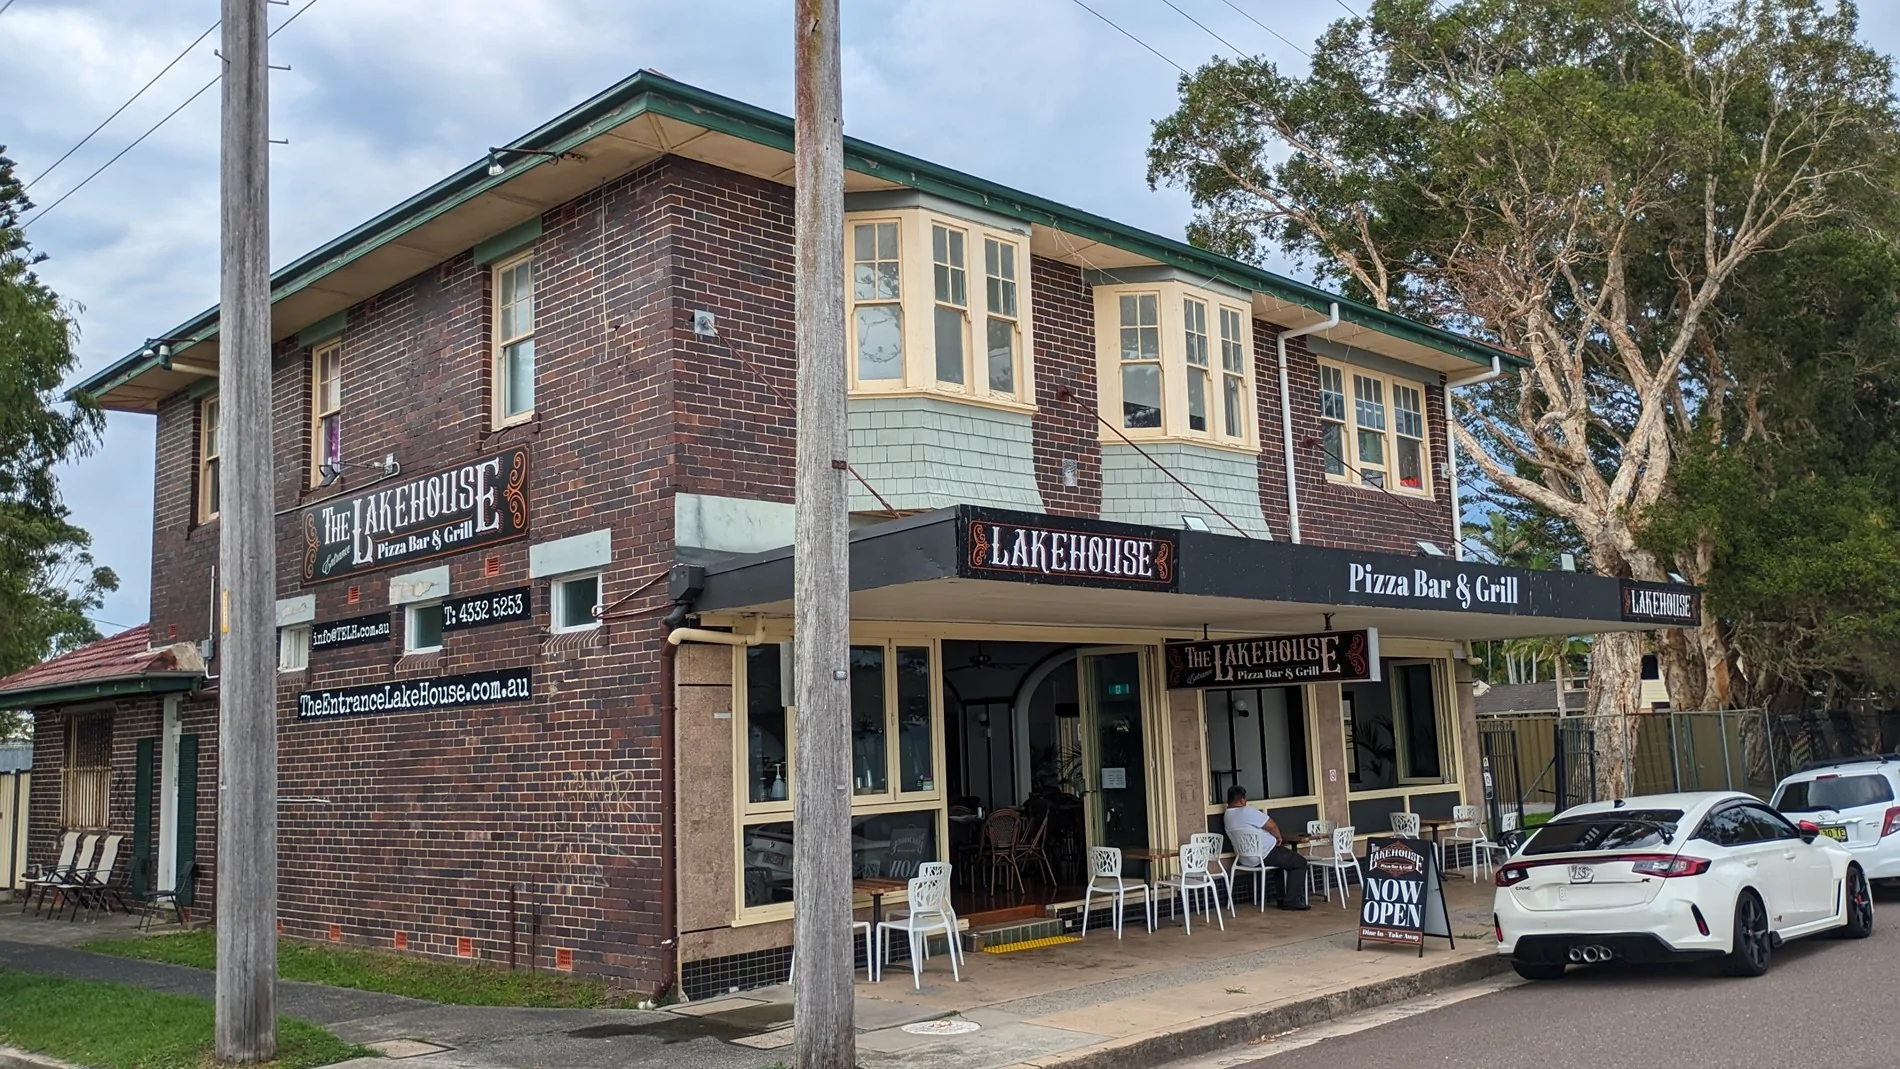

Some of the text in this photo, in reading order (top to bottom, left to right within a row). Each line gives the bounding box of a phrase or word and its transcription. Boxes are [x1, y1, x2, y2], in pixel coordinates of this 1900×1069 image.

[322, 456, 500, 566] THE LAKEHOUSE
[377, 520, 473, 560] Pizza Bar & Grill
[991, 526, 1153, 577] LAKEHOUSE
[321, 544, 351, 575] Entrance
[1349, 563, 1519, 609] Pizza Bar & Grill
[444, 594, 523, 625] T: 4332 5253
[1631, 589, 1691, 618] LAKEHOUSE
[313, 621, 390, 646] info@TELH.com.au
[1185, 635, 1341, 682] THE LAKEHOUSE
[1237, 665, 1320, 680] Pizza Bar & Grill
[1186, 668, 1213, 685] Entrance
[300, 677, 529, 717] TheEntranceLakeHouse.com.au
[1369, 848, 1424, 875] LAKEHOUSE
[1365, 878, 1424, 904] NOW
[1363, 901, 1422, 928] OPEN
[1403, 933, 1419, 942] Away
